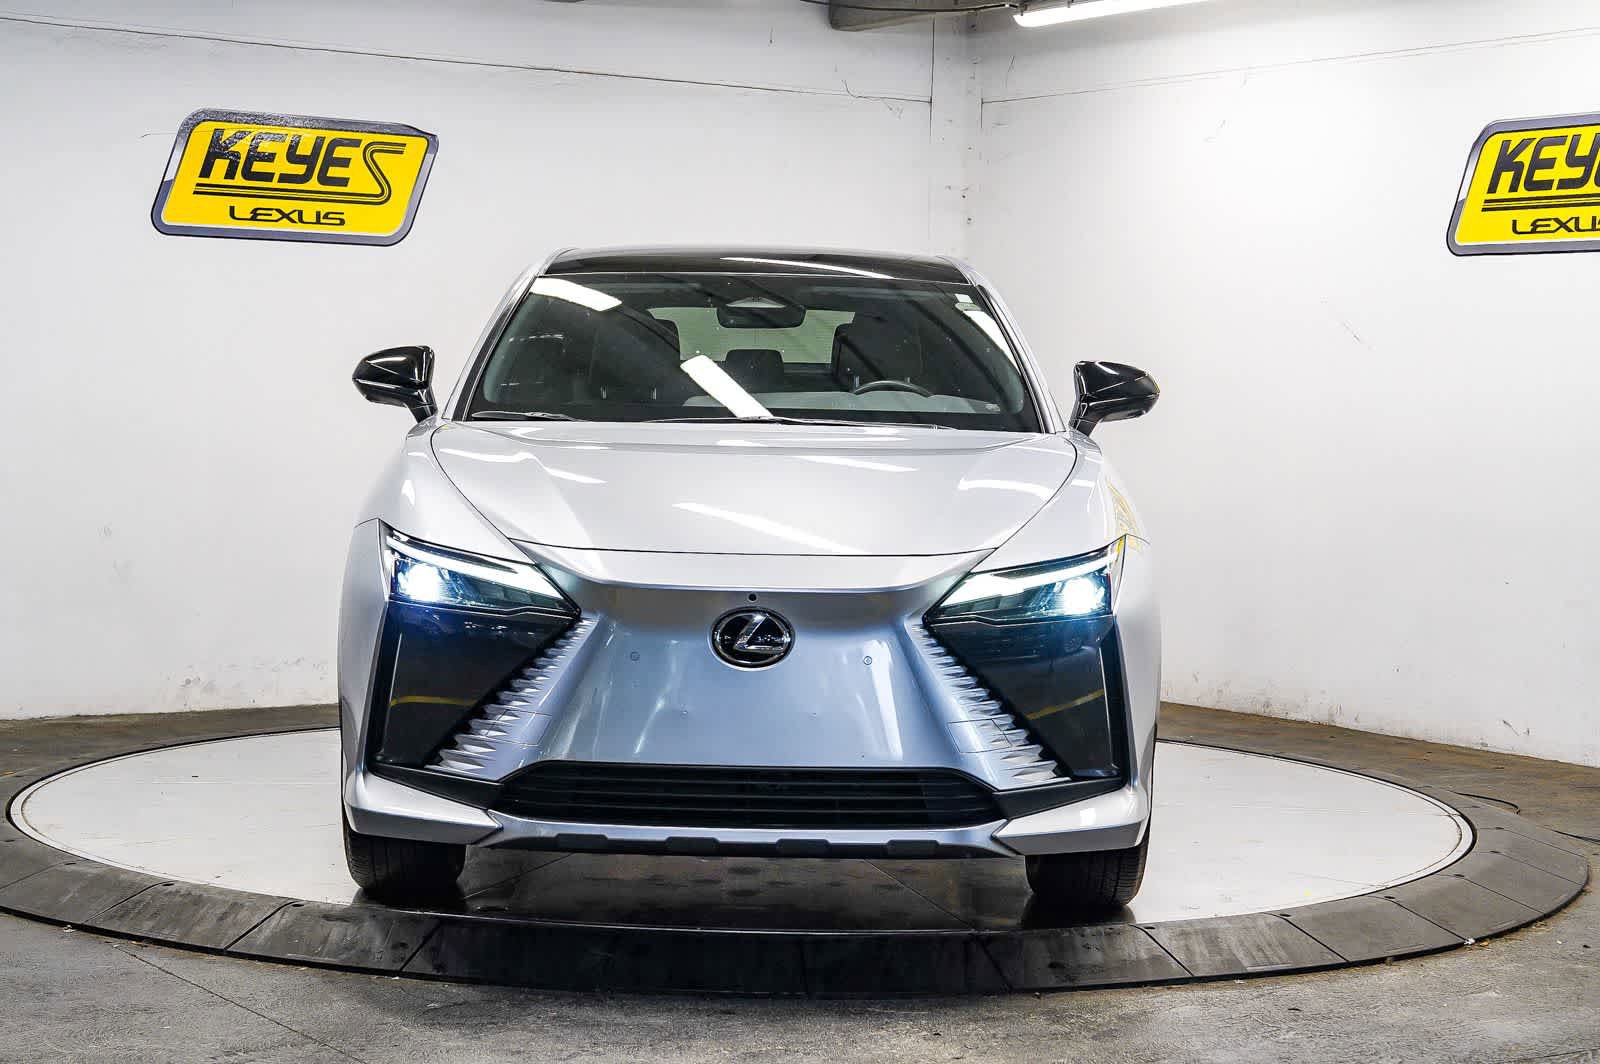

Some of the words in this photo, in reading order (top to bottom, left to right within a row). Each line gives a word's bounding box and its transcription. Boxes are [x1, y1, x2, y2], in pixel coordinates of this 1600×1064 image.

[197, 128, 407, 205] KEYES
[1486, 133, 1600, 194] KEY
[229, 205, 346, 226] LEXUS
[1512, 216, 1600, 235] LEXU
